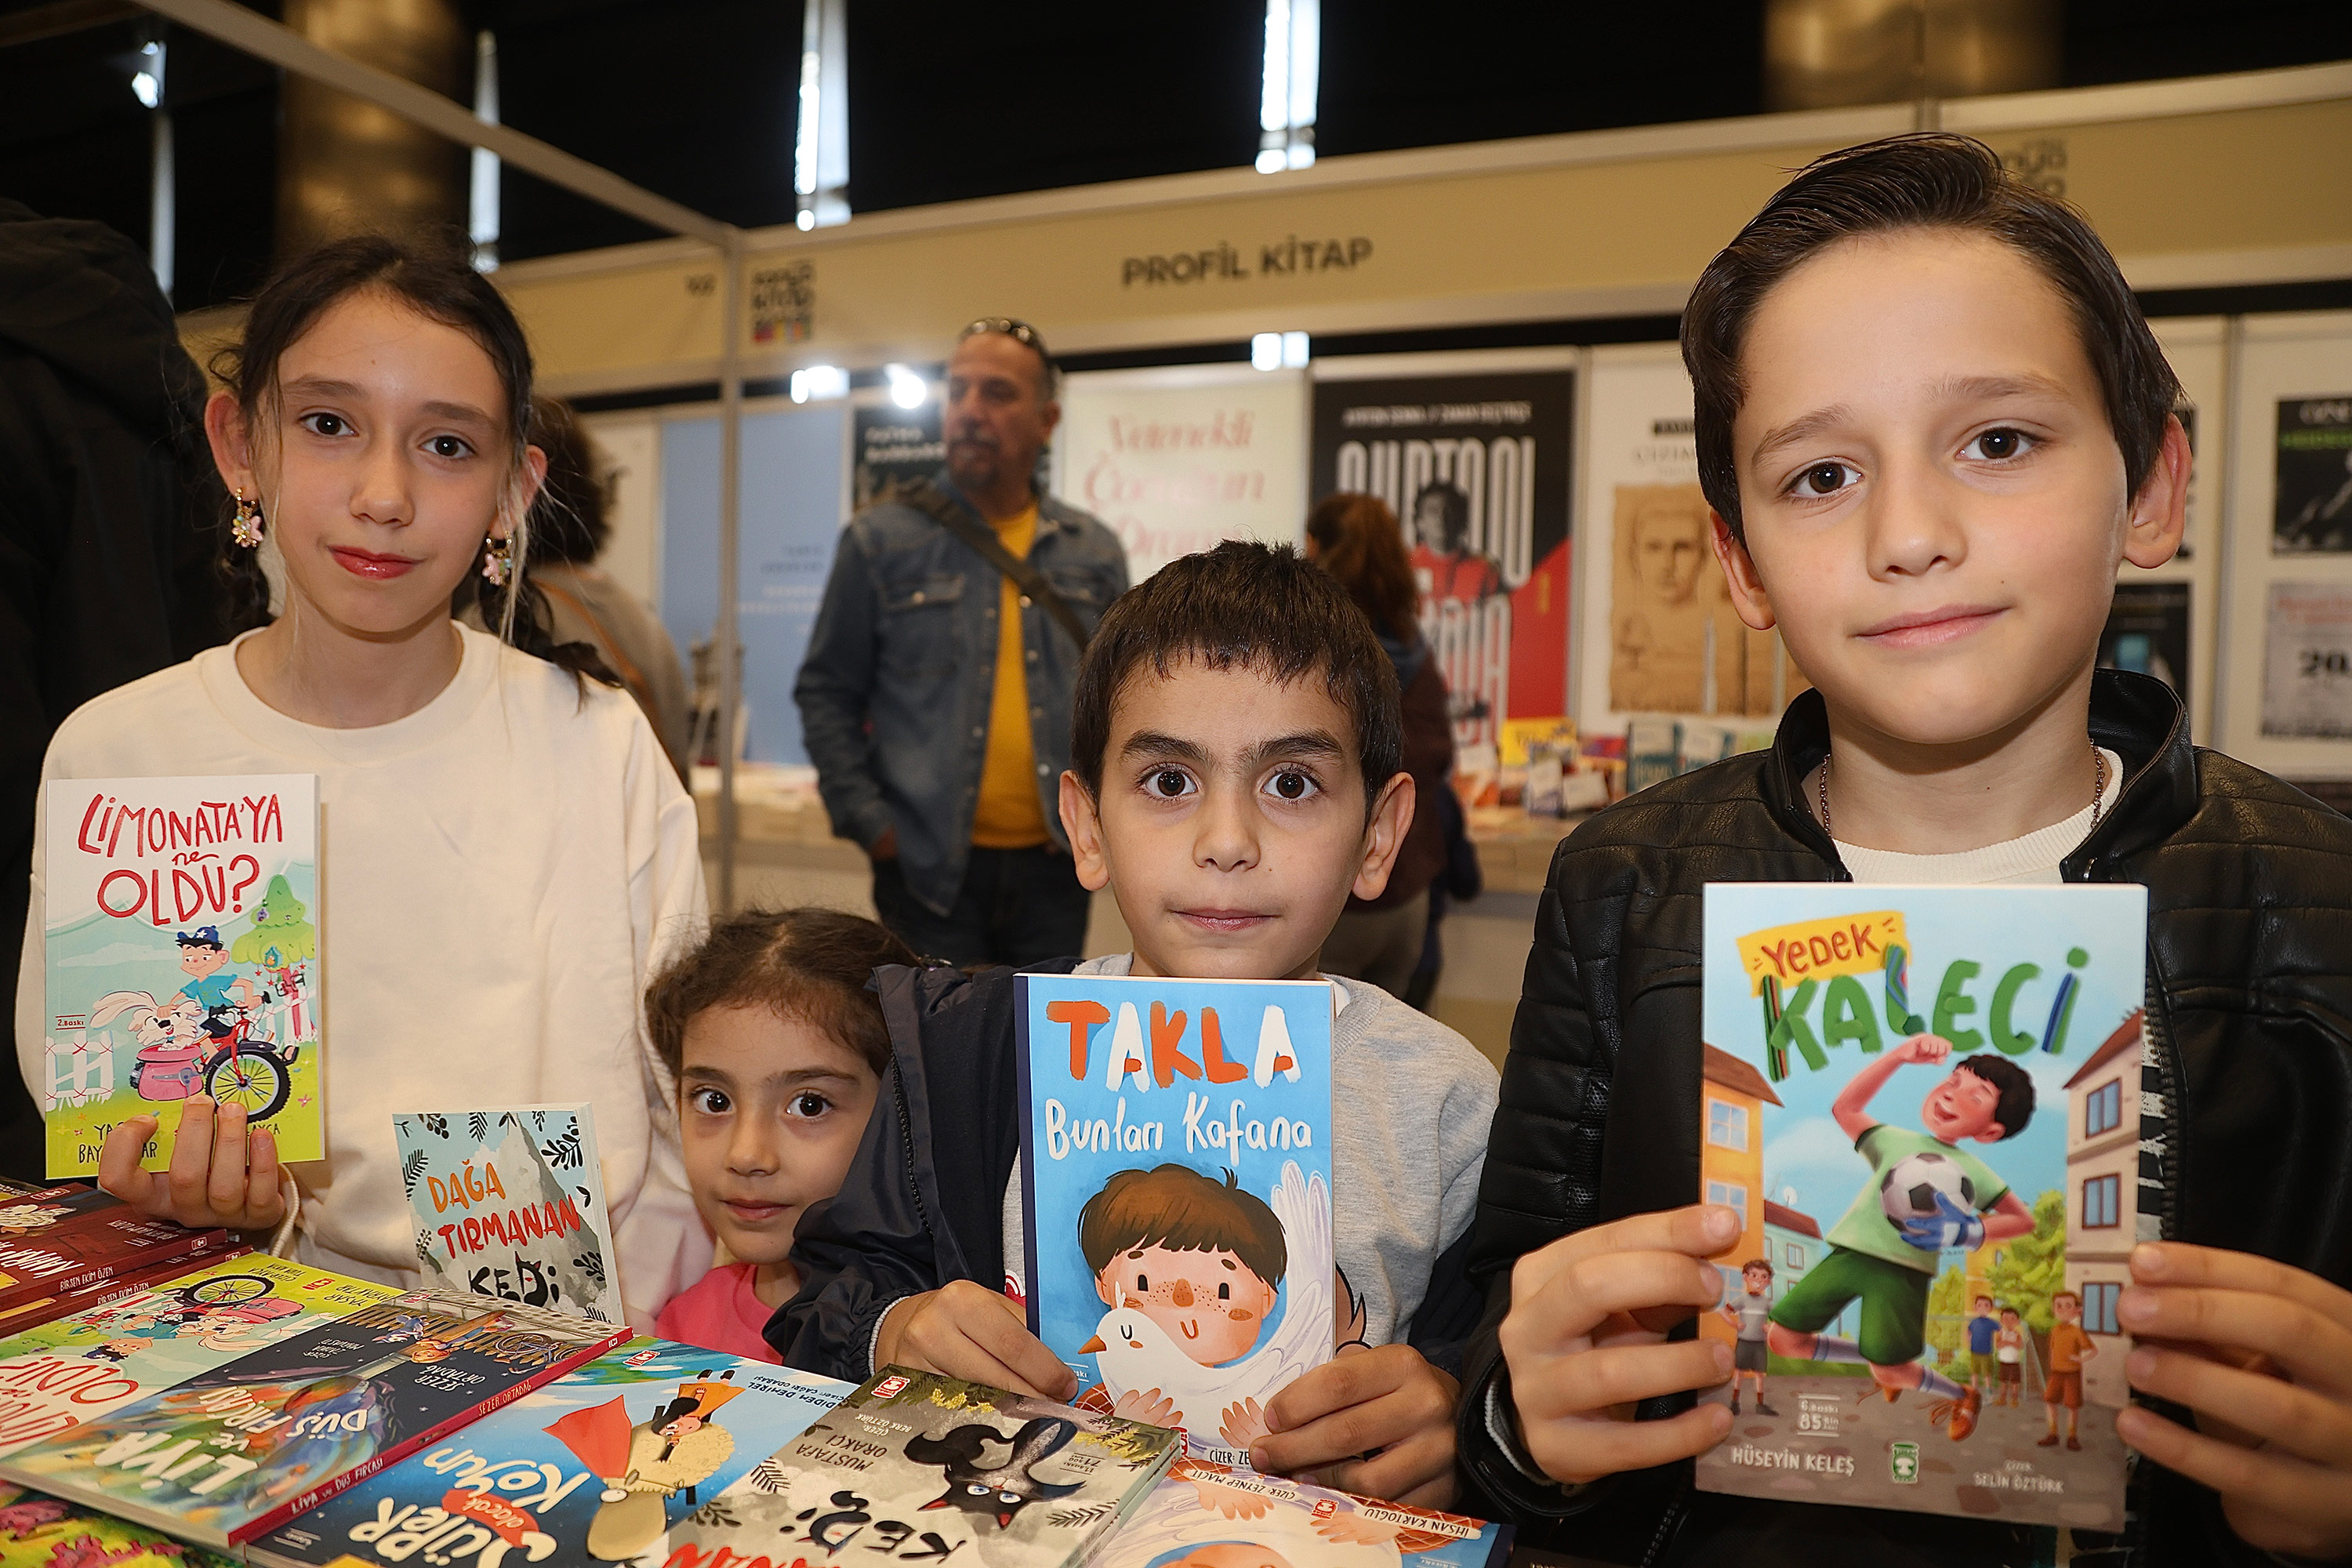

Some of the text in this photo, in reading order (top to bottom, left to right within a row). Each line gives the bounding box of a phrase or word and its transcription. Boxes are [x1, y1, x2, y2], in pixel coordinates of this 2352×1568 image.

[78, 793, 283, 858] LİMONATA'YA
[97, 854, 260, 927] OLDU?
[1046, 1000, 1303, 1093] TAKLA
[1046, 1091, 1313, 1167] Bunları Kafana
[427, 1159, 506, 1213] DAĞA
[437, 1194, 581, 1259] TIRMANAN
[285, 1409, 368, 1439] DÜŞ
[478, 1396, 499, 1417] SEZER
[1800, 1412, 1822, 1431] 85
[93, 1431, 259, 1495] LİVA
[796, 1443, 874, 1472] MUSTAFA
[1732, 1445, 1856, 1476] HÜSEYİN KELEŞ
[1227, 1479, 1266, 1494] ZEYNEP
